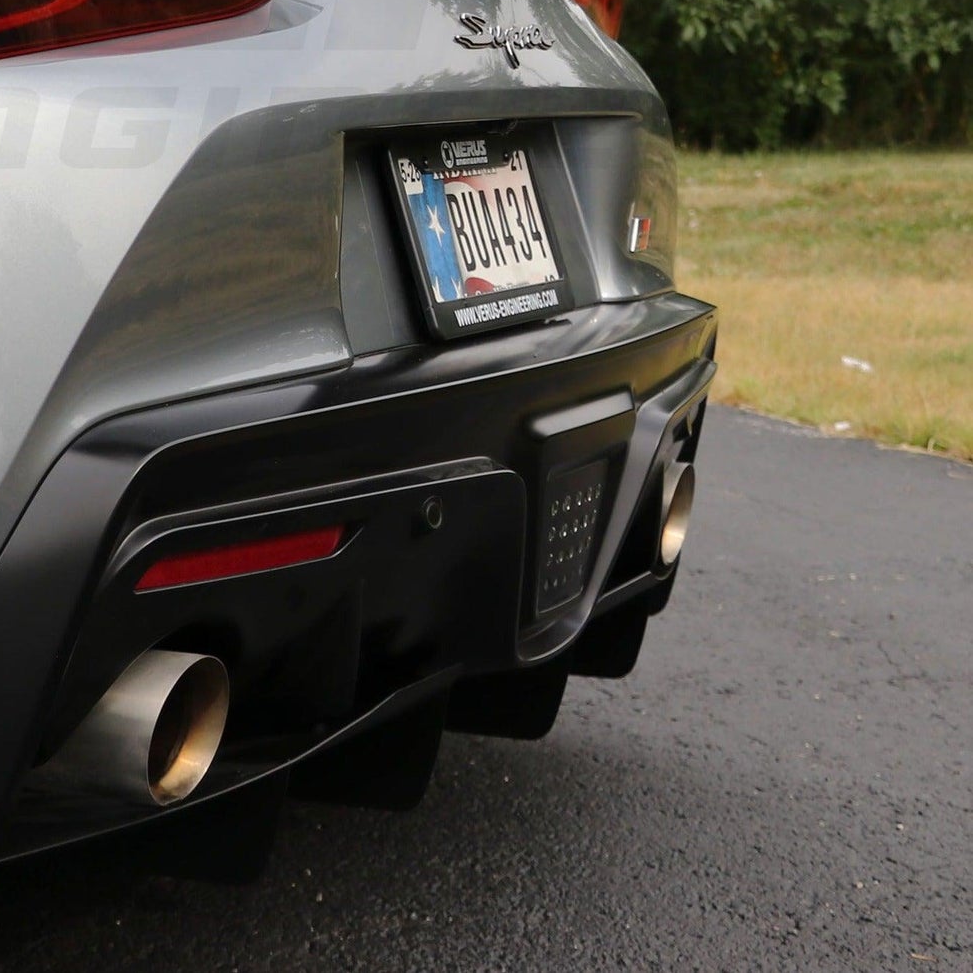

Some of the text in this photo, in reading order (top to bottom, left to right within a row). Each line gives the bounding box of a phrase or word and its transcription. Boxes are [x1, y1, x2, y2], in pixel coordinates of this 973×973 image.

[453, 12, 555, 69] Supra
[451, 140, 487, 158] VERUS
[446, 185, 547, 272] BUA434
[454, 289, 559, 327] WWW.VERUS-ENGINEERING.COM
